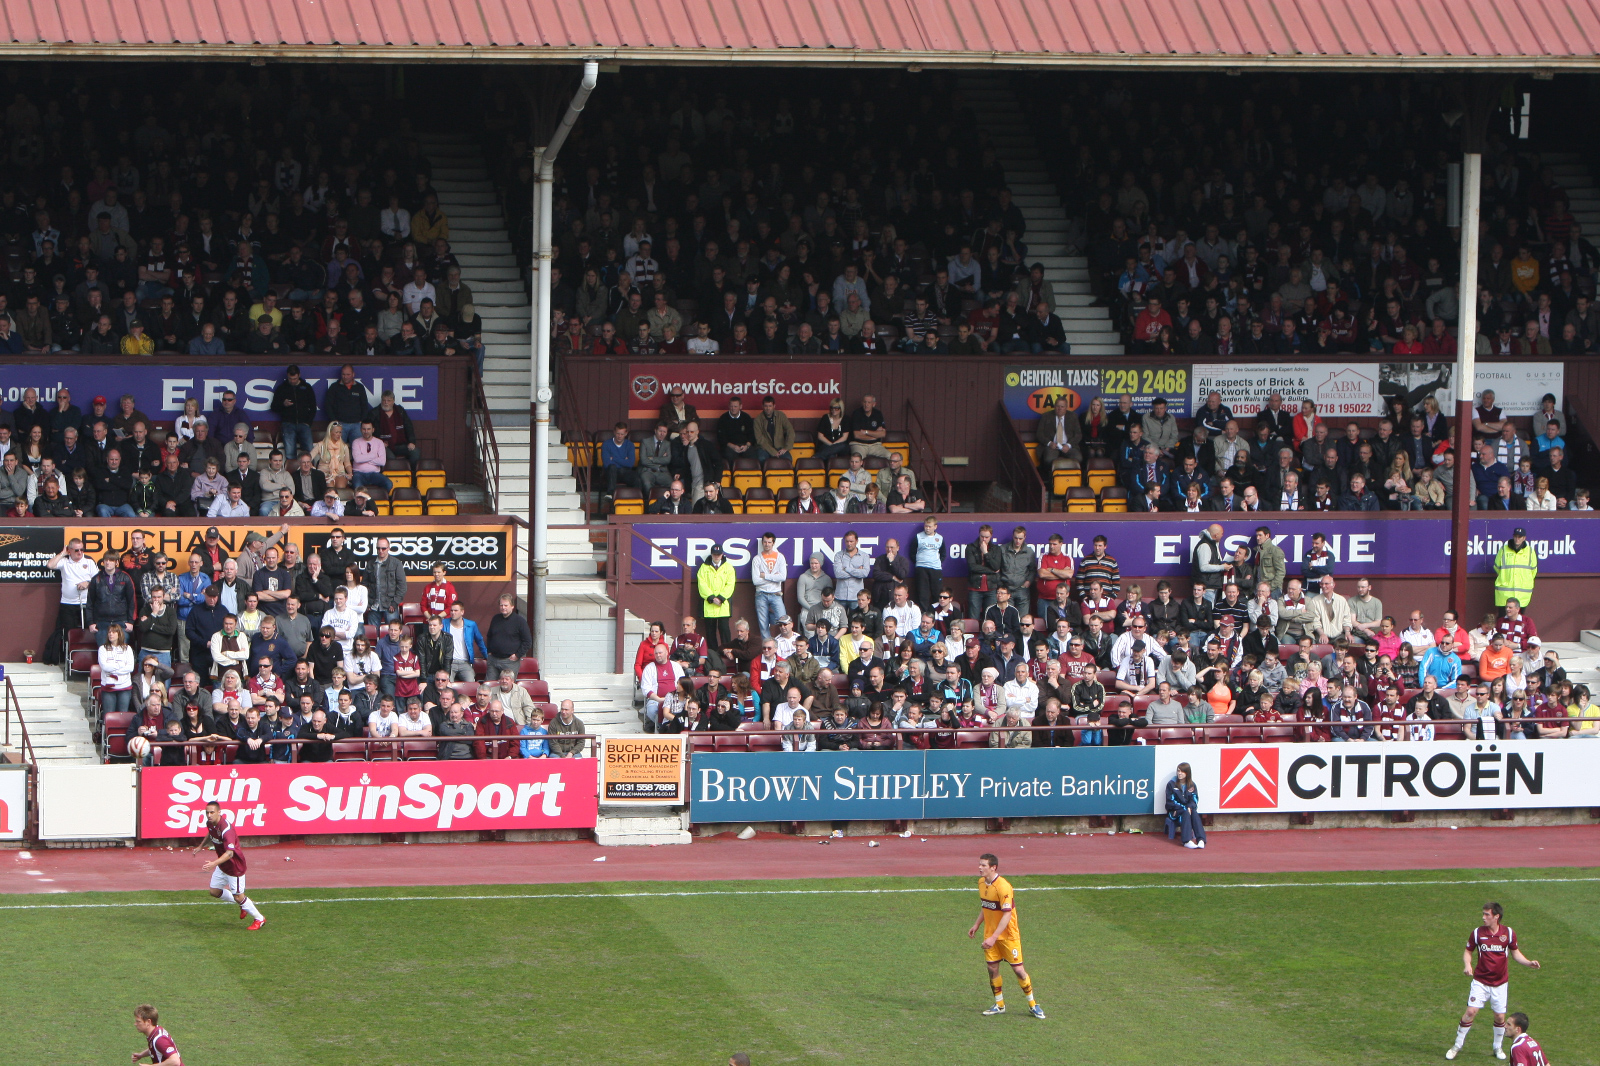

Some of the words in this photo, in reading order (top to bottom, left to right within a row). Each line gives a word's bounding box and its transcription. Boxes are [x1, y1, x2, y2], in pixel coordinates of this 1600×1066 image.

[1020, 369, 1064, 387] CENTRAL
[1067, 369, 1099, 387] TAXIS
[1105, 369, 1139, 394] 229
[1142, 369, 1187, 394] 2468
[1199, 378, 1212, 387] All
[1215, 379, 1254, 388] aspects
[1256, 378, 1267, 386] of
[1269, 378, 1295, 387] Brick
[1330, 381, 1362, 392] ABM
[1338, 403, 1372, 413] 195022
[436, 536, 498, 556] 7888
[607, 744, 680, 753] BUCHANAN
[607, 753, 641, 763] SKIP
[645, 753, 679, 763] HIRE
[1286, 743, 1543, 800] CITROËN
[168, 770, 261, 803] Sun
[616, 783, 635, 791] 0131
[698, 767, 822, 803] BROWN
[833, 765, 971, 801] SHIPLEY
[980, 775, 1052, 798] Private
[1061, 775, 1149, 800] Banking
[283, 772, 566, 829] SunSport
